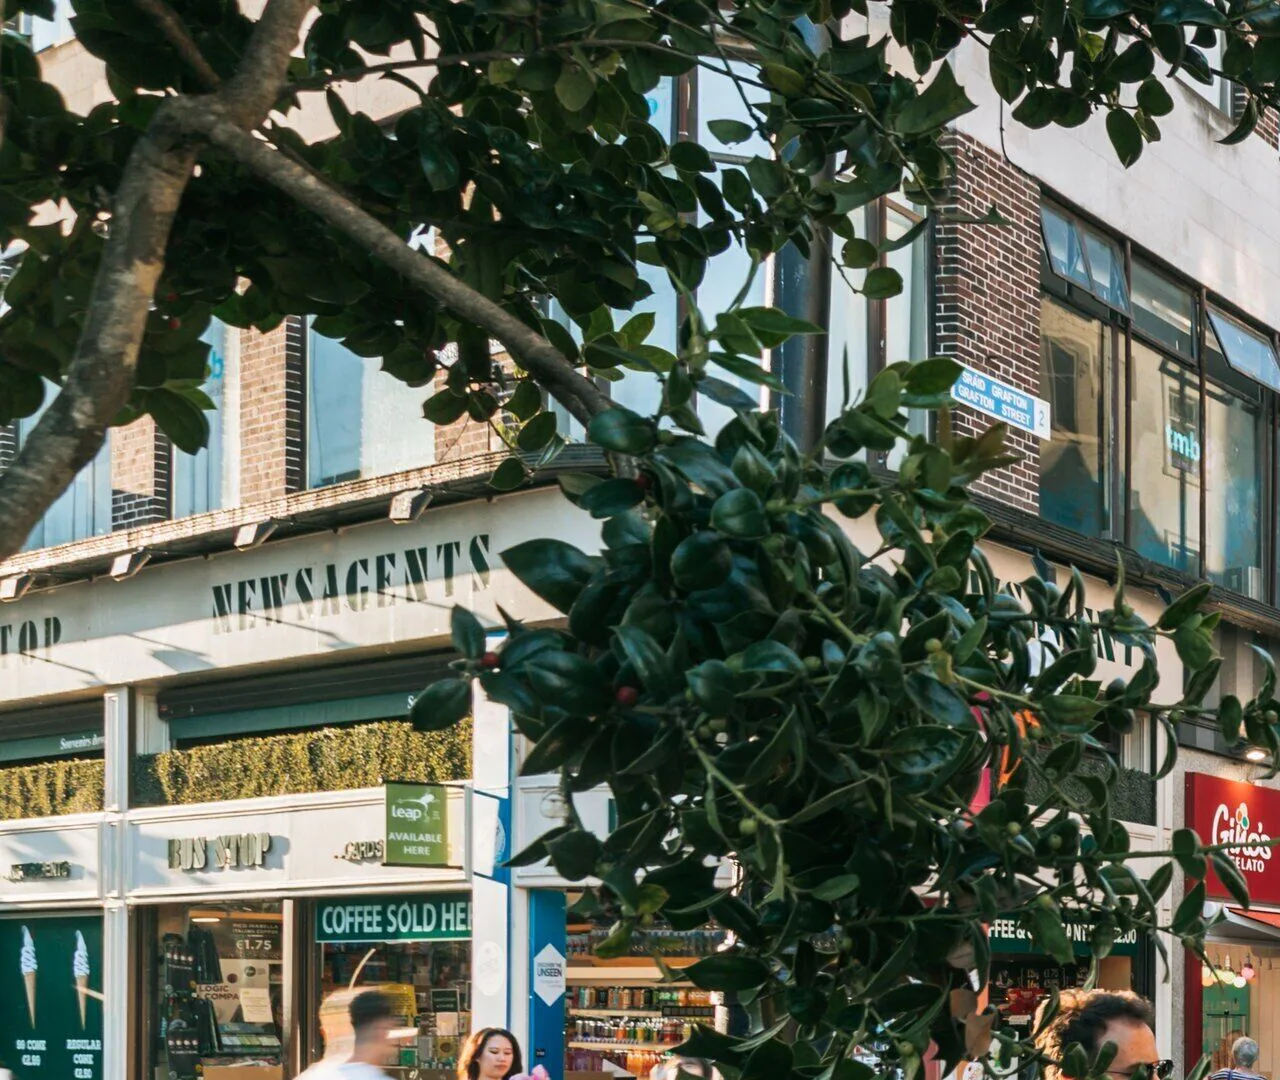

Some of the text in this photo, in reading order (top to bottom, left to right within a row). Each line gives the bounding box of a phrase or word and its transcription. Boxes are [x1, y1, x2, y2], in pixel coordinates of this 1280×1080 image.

[958, 384, 1045, 427] GRAFTON STREET 2
[991, 384, 1028, 410] GRAFTON
[1165, 424, 1200, 461] tmb
[213, 534, 491, 634] NEWSAGENTS
[168, 836, 206, 869] BUS
[388, 832, 442, 843] AVAILABLE
[403, 846, 430, 856] HERE
[322, 905, 382, 934] COFFEE
[386, 901, 436, 932] SOLD
[236, 939, 273, 950] €1.75
